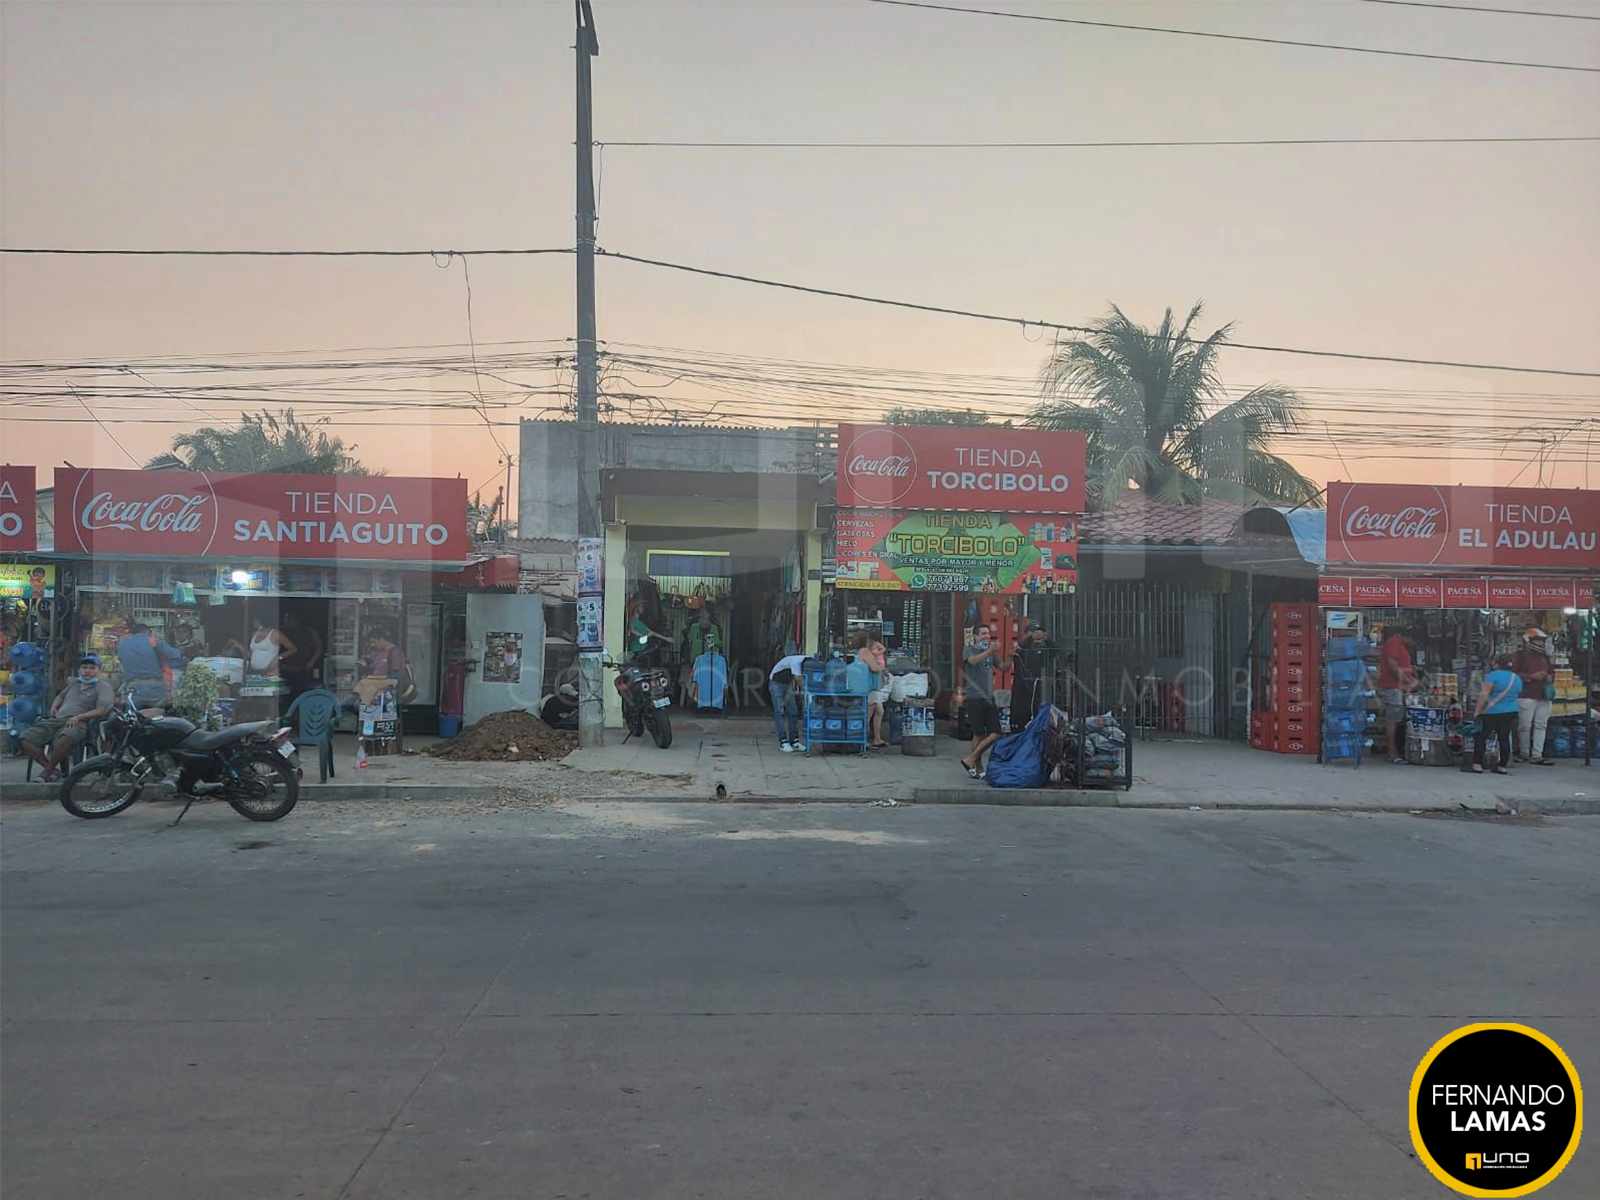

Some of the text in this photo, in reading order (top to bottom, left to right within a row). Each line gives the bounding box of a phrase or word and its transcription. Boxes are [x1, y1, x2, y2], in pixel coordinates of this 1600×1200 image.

[955, 448, 1043, 467] TIENDA
[927, 471, 1069, 492] TORCIBOLO
[82, 491, 208, 533] Coca-Cola
[286, 491, 398, 515] TIENDA
[926, 514, 992, 529] TIENDA
[1346, 505, 1442, 539] Coca-Cola
[1485, 504, 1573, 524] TIENDA
[233, 520, 448, 545] SANTIAGUITO
[1459, 528, 1596, 550] EL ADULAU
[889, 533, 1025, 557] "TORCIBOLO"
[949, 559, 976, 568] MAYOR
[986, 560, 1013, 568] MENOR
[1356, 584, 1391, 594] PACEÑA
[1402, 584, 1437, 595] PACEÑA
[1448, 585, 1482, 595] PACEÑA
[1492, 586, 1526, 596] PACEÑA
[1537, 587, 1569, 596] PACEÑA
